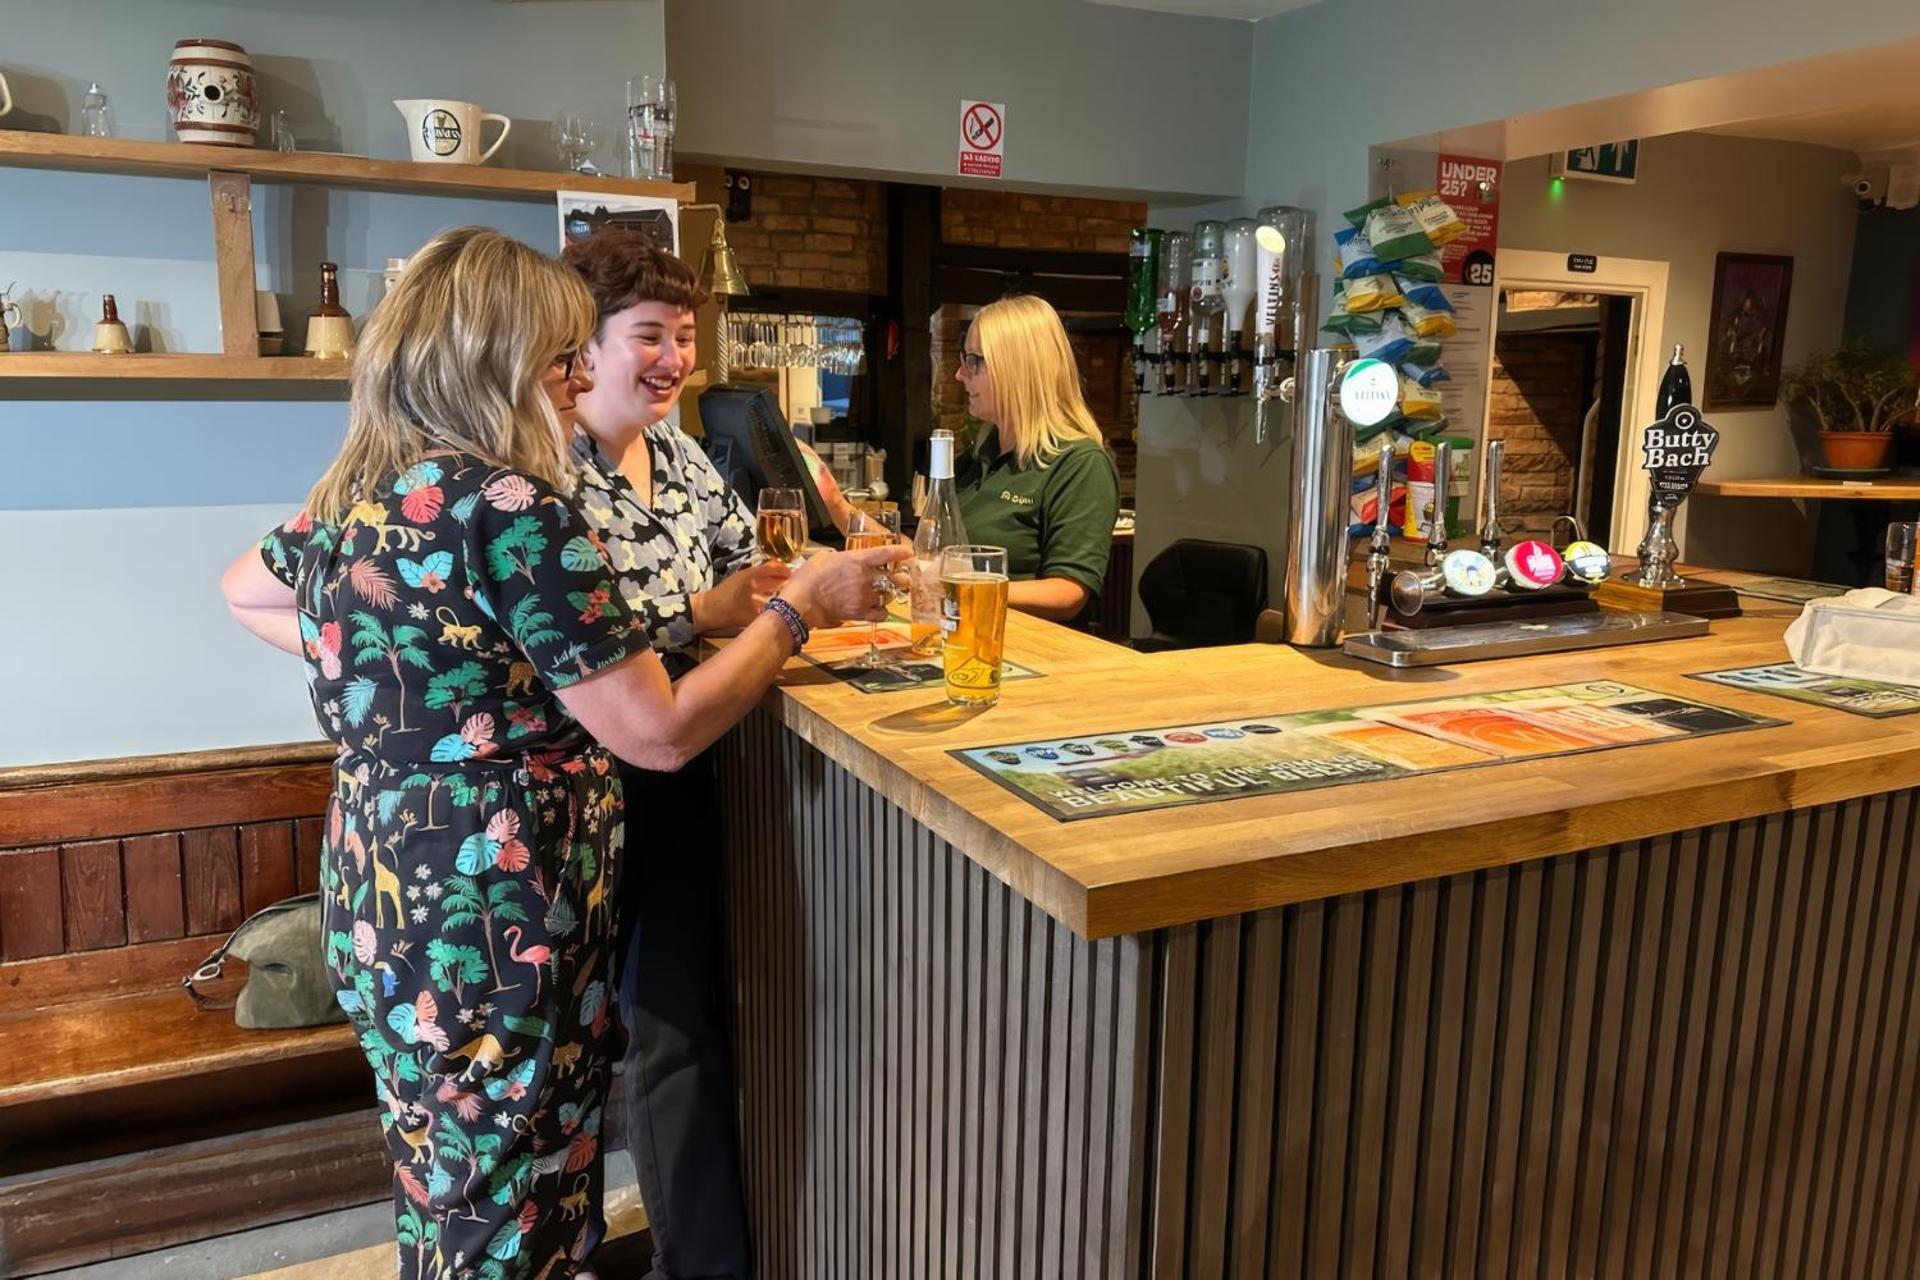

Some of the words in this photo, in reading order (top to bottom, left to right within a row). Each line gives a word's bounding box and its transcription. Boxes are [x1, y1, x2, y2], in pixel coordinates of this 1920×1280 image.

[1441, 161, 1497, 183] UNDER
[1440, 180, 1468, 197] 25?
[1469, 263, 1493, 284] 25
[1644, 429, 1717, 450] Butty
[1644, 446, 1711, 468] Bach
[1061, 773, 1270, 808] BEAUTIFUL
